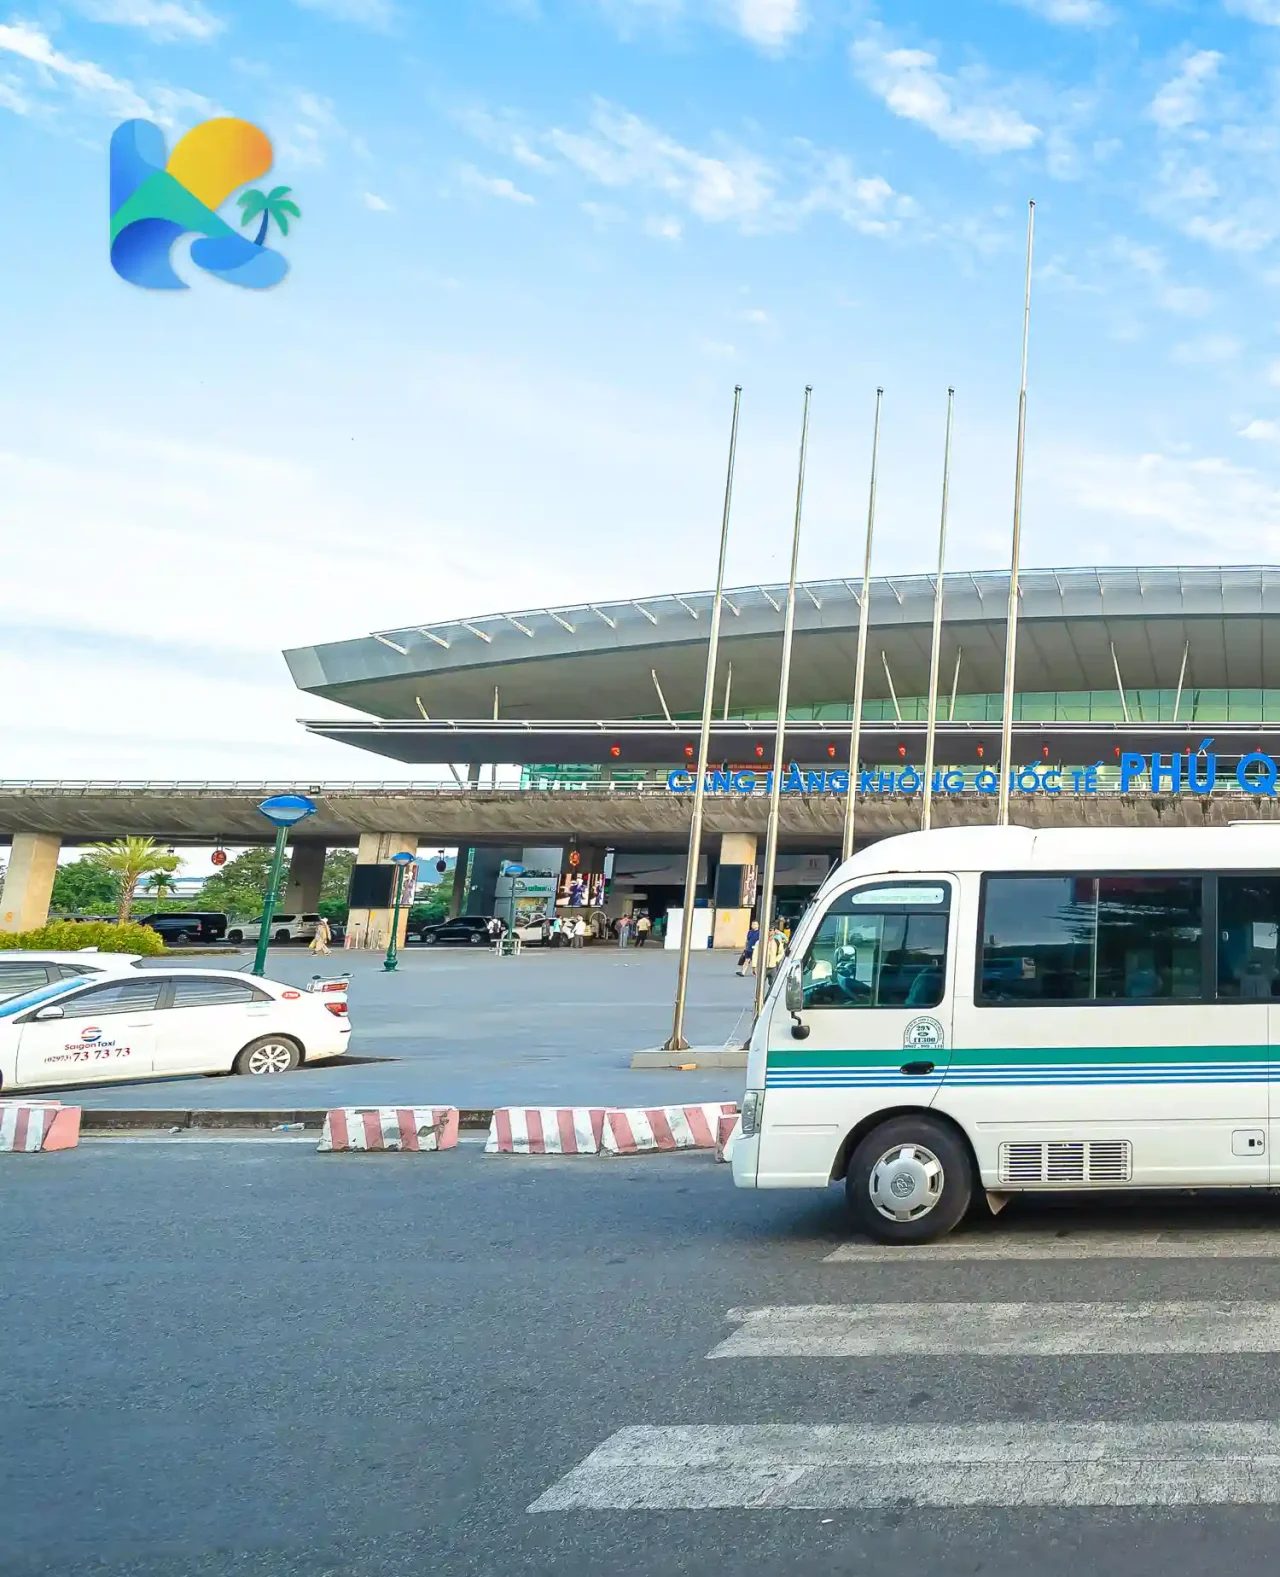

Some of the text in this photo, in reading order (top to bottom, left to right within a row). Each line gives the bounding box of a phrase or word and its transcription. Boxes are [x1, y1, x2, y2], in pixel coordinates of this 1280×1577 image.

[860, 765, 965, 793] KHÔNG
[1071, 760, 1104, 793] TẾ
[1120, 738, 1216, 793] PHÚ
[73, 1051, 89, 1062] 73
[94, 1049, 110, 1060] 73
[115, 1047, 131, 1058] 73
